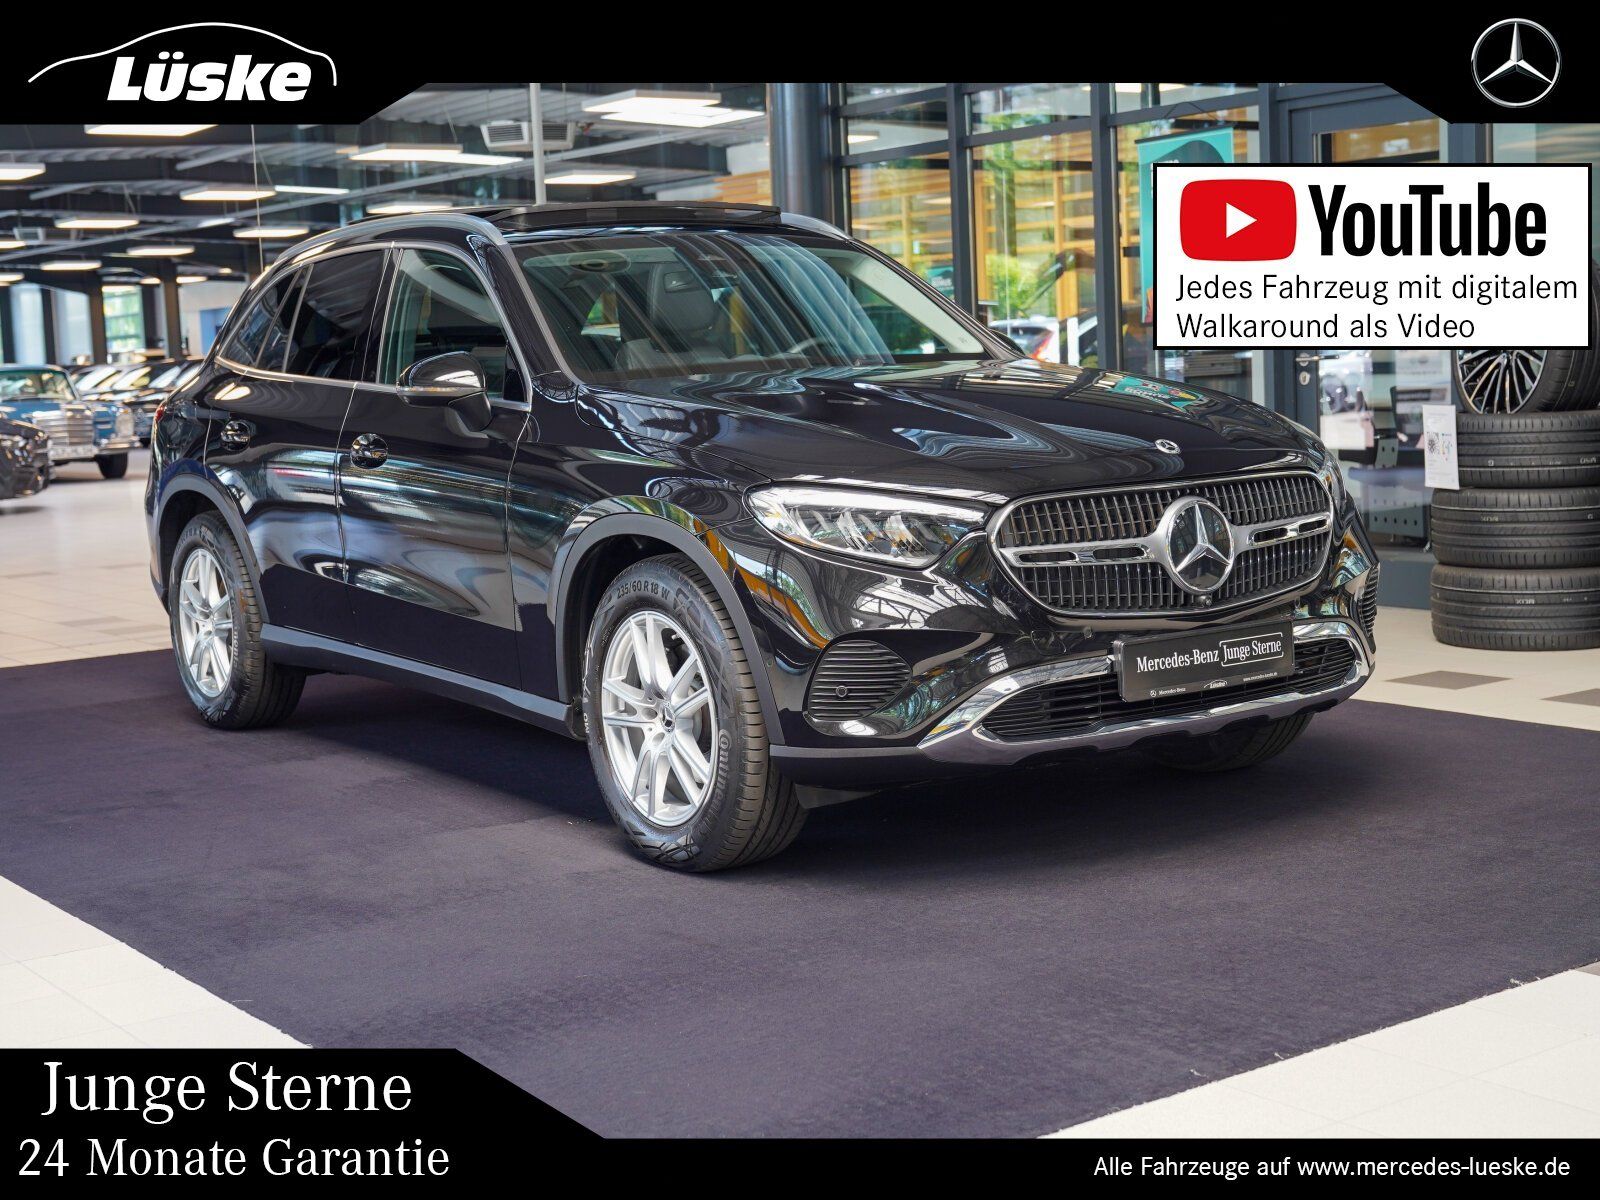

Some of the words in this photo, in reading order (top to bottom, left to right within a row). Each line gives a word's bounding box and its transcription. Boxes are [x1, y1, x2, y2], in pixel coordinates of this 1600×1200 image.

[617, 580, 642, 599] 235/60
[643, 580, 649, 592] R
[650, 581, 659, 594] 18
[1136, 649, 1219, 673] Mercedes-Benz
[1222, 644, 1250, 662] Junge
[1252, 640, 1282, 656] Sterne
[700, 729, 732, 835] Continen
